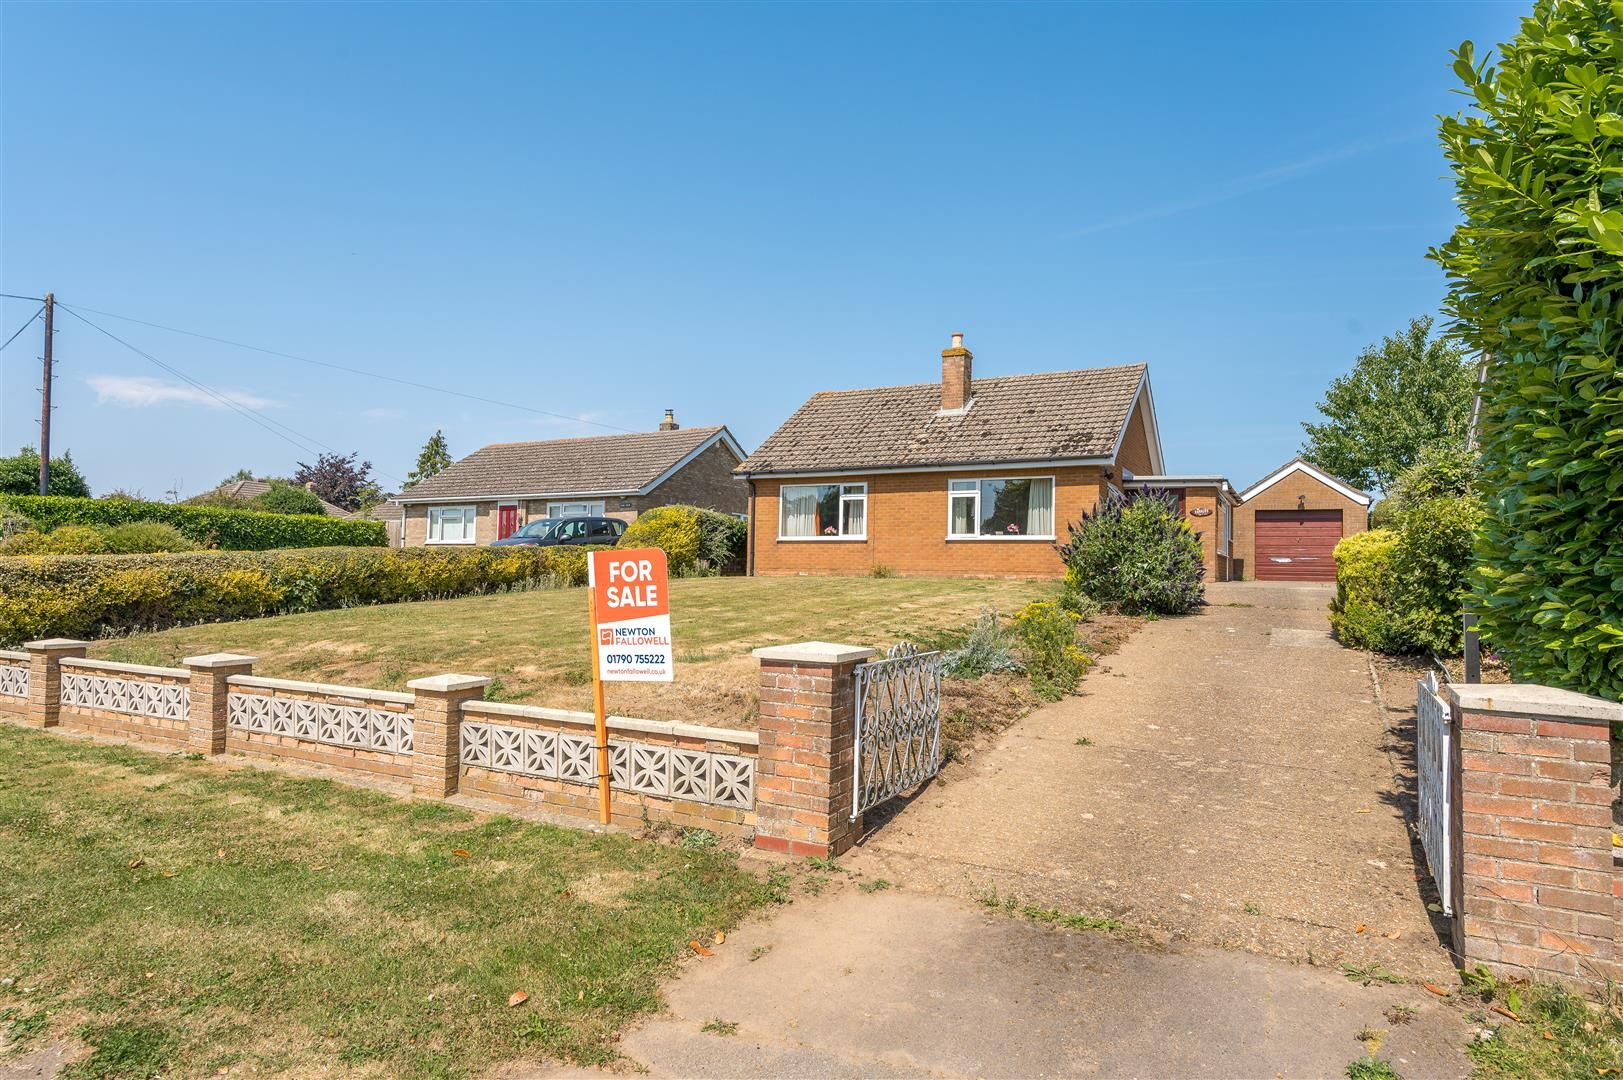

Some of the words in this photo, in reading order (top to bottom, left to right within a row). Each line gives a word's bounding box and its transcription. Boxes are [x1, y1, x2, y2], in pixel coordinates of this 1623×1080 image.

[609, 560, 653, 583] FOR
[606, 584, 658, 608] SALE
[615, 627, 656, 637] NEWTON
[615, 637, 669, 646] FALLOWELL
[606, 654, 633, 664] 01790
[634, 654, 665, 664] 755222
